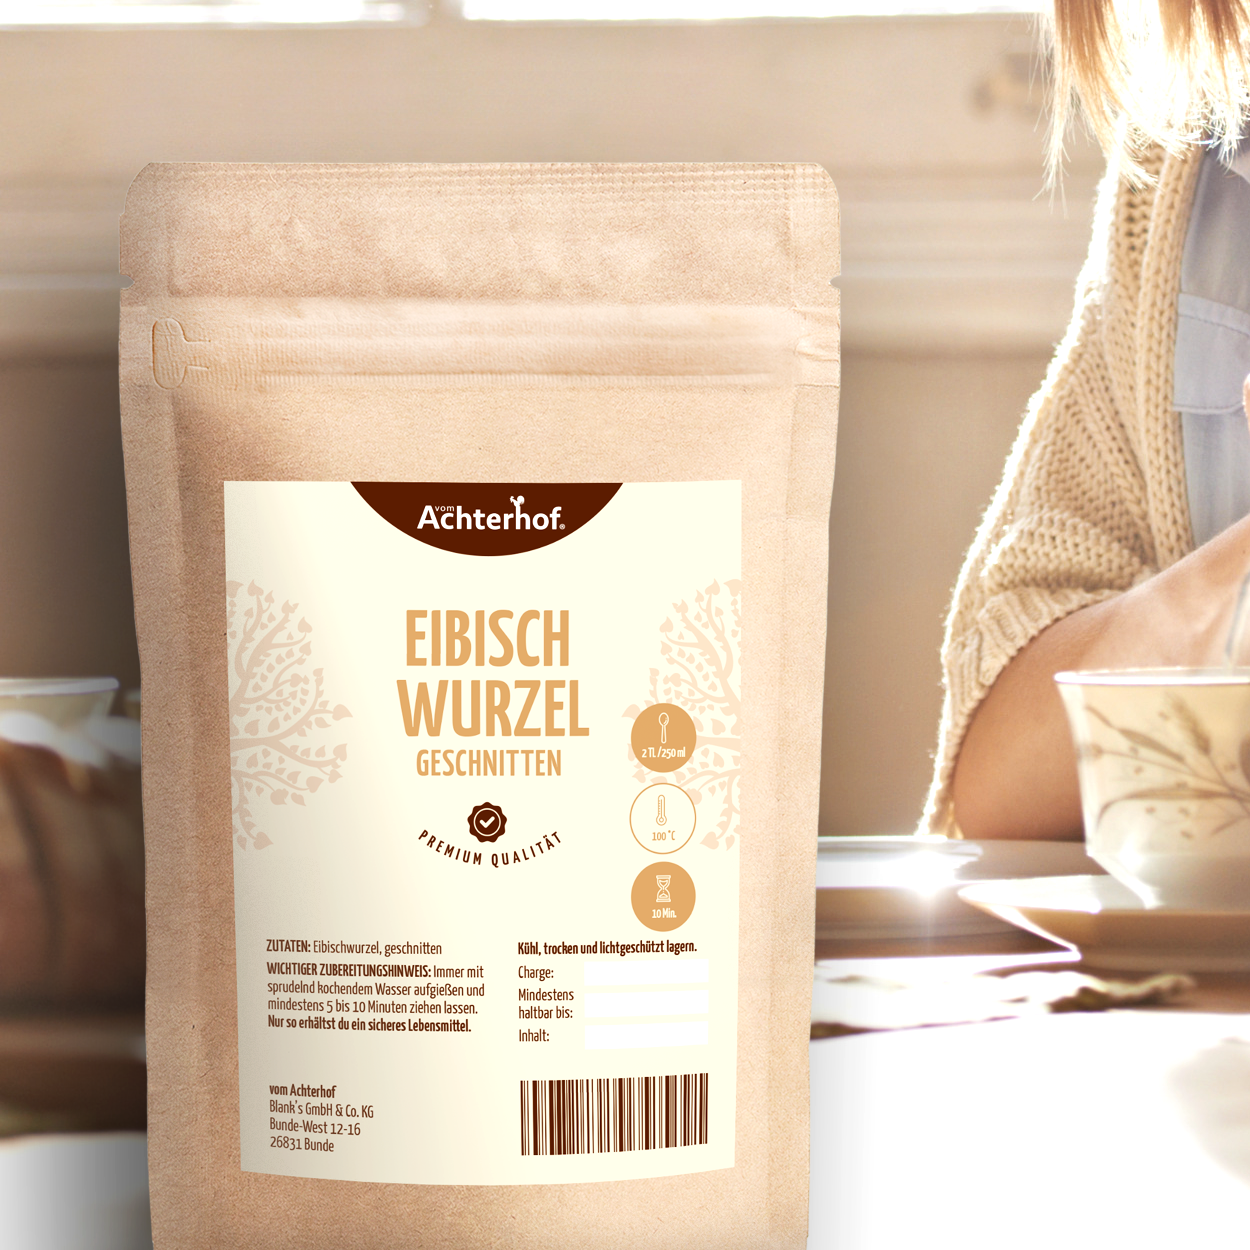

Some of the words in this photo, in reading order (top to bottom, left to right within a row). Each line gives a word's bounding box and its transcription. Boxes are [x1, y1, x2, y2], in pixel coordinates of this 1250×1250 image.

[406, 609, 569, 667] EIBISCH
[396, 680, 589, 737] WURZEL
[641, 748, 647, 758] 2
[648, 747, 656, 758] TL
[677, 746, 686, 758] ml
[416, 749, 561, 776] GESCHNITTEN
[652, 832, 666, 841] 100
[418, 829, 482, 865] PREMIUM
[491, 831, 561, 868] QUALITÄT
[652, 909, 661, 918] 10
[662, 908, 677, 918] Min.
[266, 939, 311, 952] ZUTATEN:
[313, 940, 382, 955] Eibischwurzel,
[384, 941, 442, 957] geschnitten
[518, 942, 541, 956] Kühl,
[544, 941, 578, 955] trocken
[580, 941, 597, 954] und
[599, 940, 665, 957] lichtgeschützt
[667, 940, 697, 955] lagern.
[267, 962, 317, 976] WICHTIGER
[319, 963, 432, 977] ZUBEREITUNGSHINWEIS:
[434, 965, 464, 978] Immer
[467, 965, 484, 978] mit
[518, 965, 554, 981] Charge:
[267, 980, 315, 995] sprudelnd
[317, 981, 373, 995] kochendem
[375, 982, 410, 996] Wasser
[414, 983, 464, 999] aufgießen
[466, 983, 484, 996] und
[519, 988, 574, 1001] Mindestens
[268, 998, 324, 1012] mindestens
[326, 1001, 333, 1014] 5
[335, 999, 350, 1013] bis
[353, 1001, 365, 1013] 10
[368, 1000, 407, 1014] Minuten
[409, 1000, 442, 1014] ziehen
[444, 1001, 478, 1015] lassen.
[519, 1006, 554, 1019] haltbar
[556, 1006, 573, 1019] bis:
[268, 1015, 284, 1028] Nur
[286, 1018, 297, 1028] so
[299, 1016, 336, 1030] erhältst
[338, 1016, 350, 1030] du
[351, 1018, 366, 1031] ein
[368, 1018, 406, 1031] sicheres
[408, 1019, 471, 1032] Lebensmittel.
[519, 1029, 550, 1042] Inhalt:
[269, 1085, 287, 1095] vom
[290, 1084, 337, 1098] Achterhof
[270, 1099, 303, 1114] Blank's
[305, 1102, 332, 1116] GmbH
[335, 1104, 343, 1117] &
[345, 1104, 359, 1117] Co.
[361, 1105, 374, 1118] KG
[270, 1117, 328, 1134] Bunde-West
[330, 1123, 361, 1136] 12-16
[270, 1136, 302, 1151] 26831
[304, 1138, 334, 1152] Bunde
